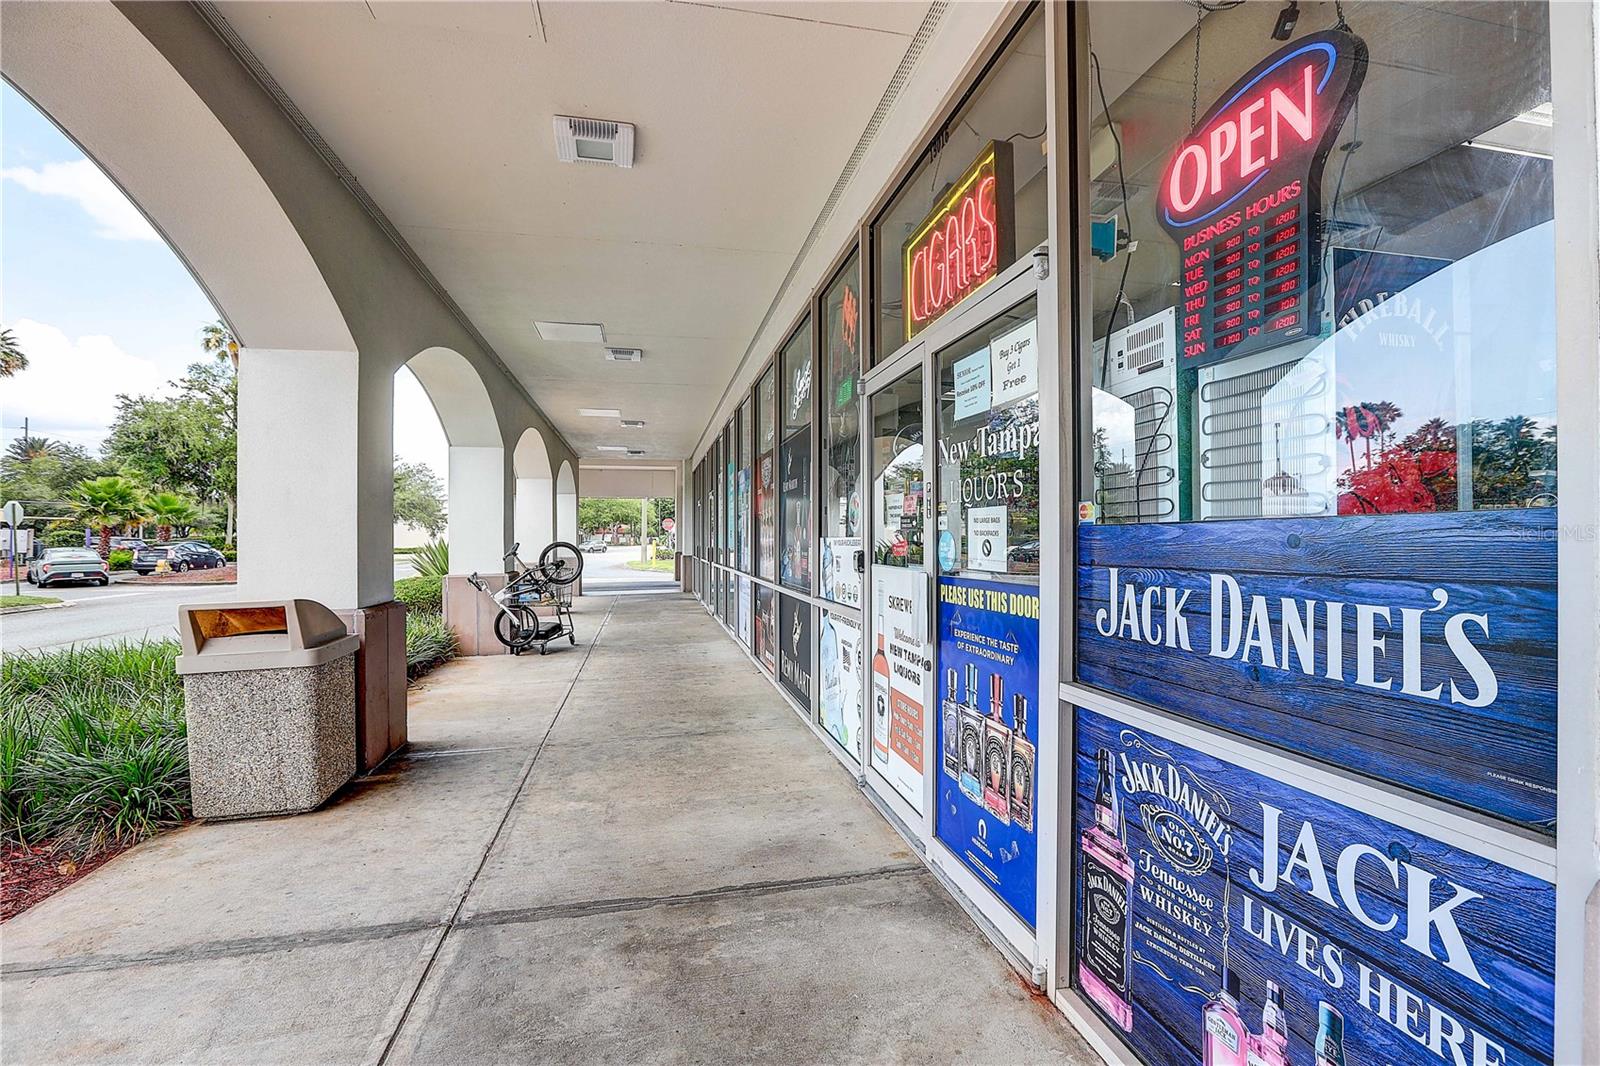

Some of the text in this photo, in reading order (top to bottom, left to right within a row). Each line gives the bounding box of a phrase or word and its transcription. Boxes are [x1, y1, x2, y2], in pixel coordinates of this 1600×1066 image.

[1170, 65, 1312, 213] OPEN
[1184, 180, 1300, 251] BUSINESS HOURS
[912, 177, 995, 320] CIGARS
[1184, 248, 1210, 268] MON
[1248, 226, 1260, 237] TO
[1185, 266, 1204, 283] TUE
[1248, 242, 1260, 253] TO
[1184, 280, 1209, 298] WED
[1248, 259, 1260, 270] TO
[1185, 296, 1206, 313] THU
[1248, 276, 1260, 287] TO
[1184, 313, 1200, 328] FRI
[1248, 293, 1260, 303] TO
[1184, 328, 1202, 342] SAT
[1248, 309, 1260, 319] TO
[1339, 291, 1449, 350] FIREBALL
[1184, 342, 1206, 358] SUN
[1248, 326, 1260, 337] TO
[1379, 332, 1416, 347] WHISKY
[1002, 375, 1027, 391] Free
[938, 437, 970, 465] New
[950, 469, 1024, 507] LIQUORS
[940, 584, 1040, 619] PLEASE USE THIS DOOR
[954, 628, 1019, 654] EXPERIENCE THE TASTE
[957, 641, 1014, 665] OF EXTRAORDINARY
[1096, 568, 1499, 708] JACK DANIEL'S
[894, 661, 920, 686] LIQUORS
[1487, 771, 1506, 781] PLEASE
[1507, 777, 1525, 786] DRINK
[1120, 753, 1234, 856] JACK DANIEL'S
[1138, 849, 1213, 911] Tennessee
[1157, 884, 1197, 912] SOUR MASH
[1249, 801, 1491, 989] JACK
[1140, 884, 1213, 937] WHISKEY
[1134, 921, 1152, 936] JACK
[1153, 931, 1178, 950] DANIEL
[1178, 945, 1216, 971] DISTILLERY
[1146, 916, 1171, 934] DISTILLED
[1177, 934, 1198, 950] BOTTLED
[1242, 894, 1345, 989] LIVES
[1356, 962, 1506, 1066] HERE
